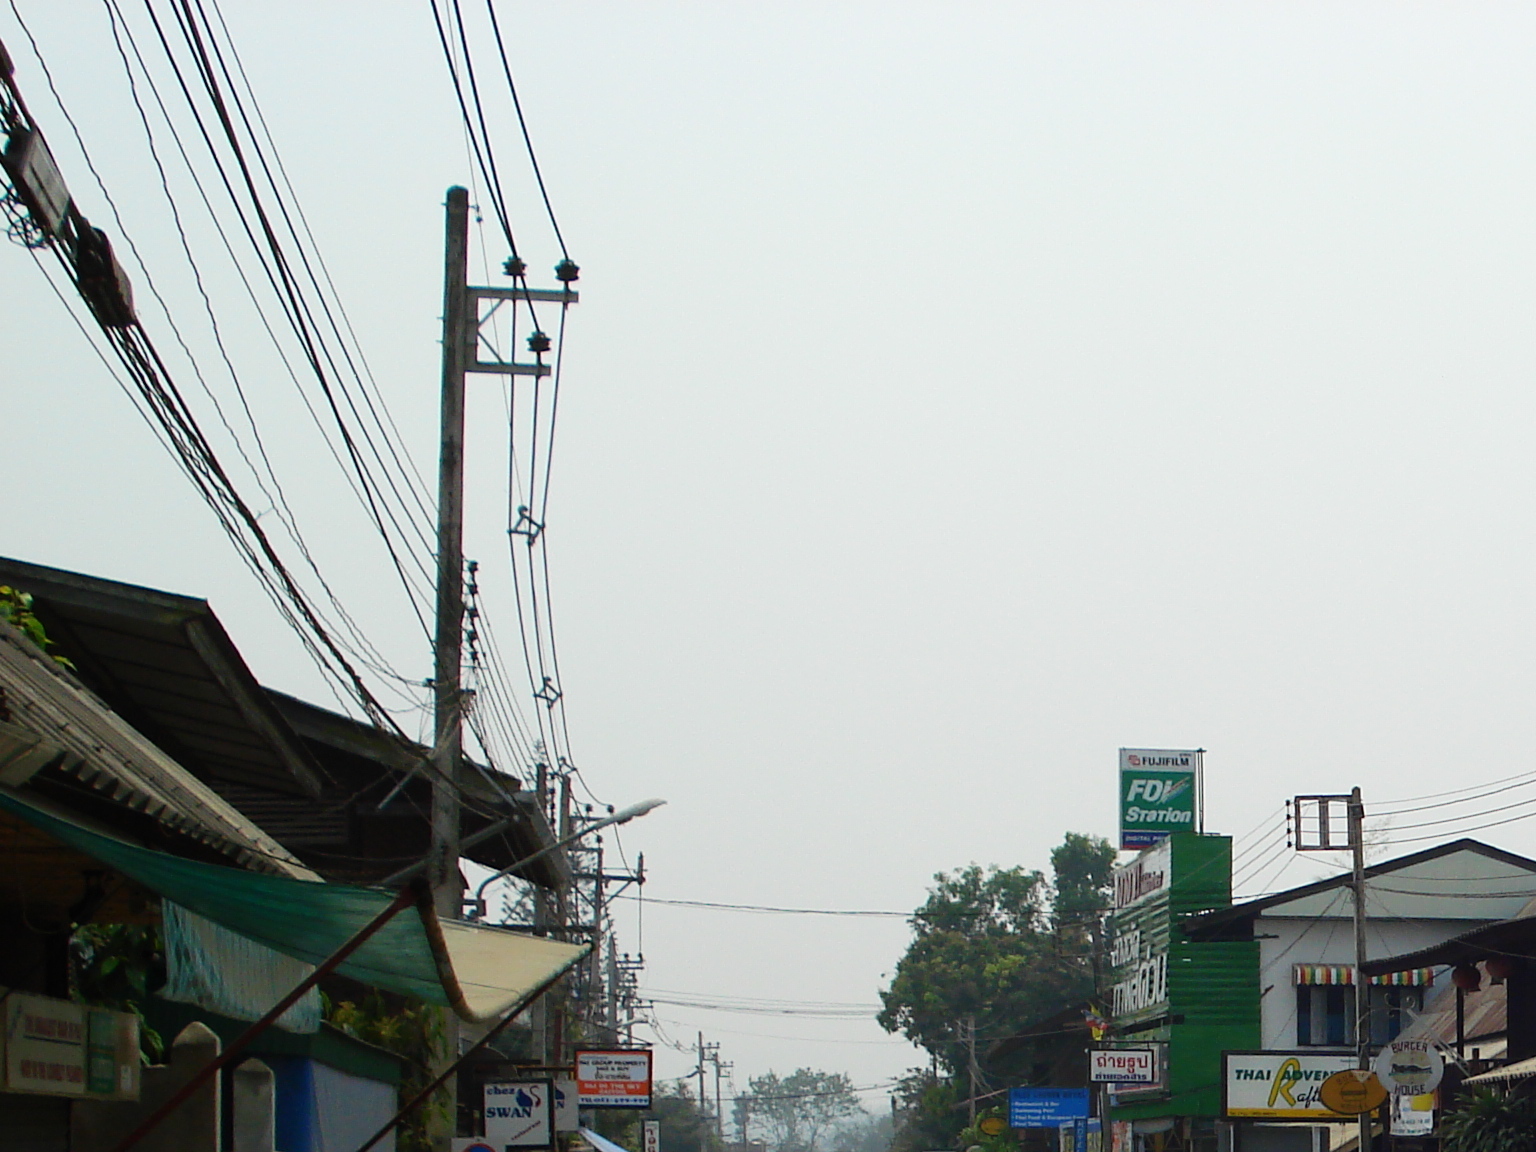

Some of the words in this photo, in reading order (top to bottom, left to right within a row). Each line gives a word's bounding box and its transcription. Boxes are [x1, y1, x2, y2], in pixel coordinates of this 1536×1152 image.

[1142, 756, 1189, 766] FUJIFILM
[1391, 1041, 1428, 1054] BURGER
[1235, 1069, 1271, 1081] THAI
[486, 1086, 515, 1095] chez
[1394, 1083, 1427, 1096] HOUSE
[486, 1106, 532, 1118] SWAN
